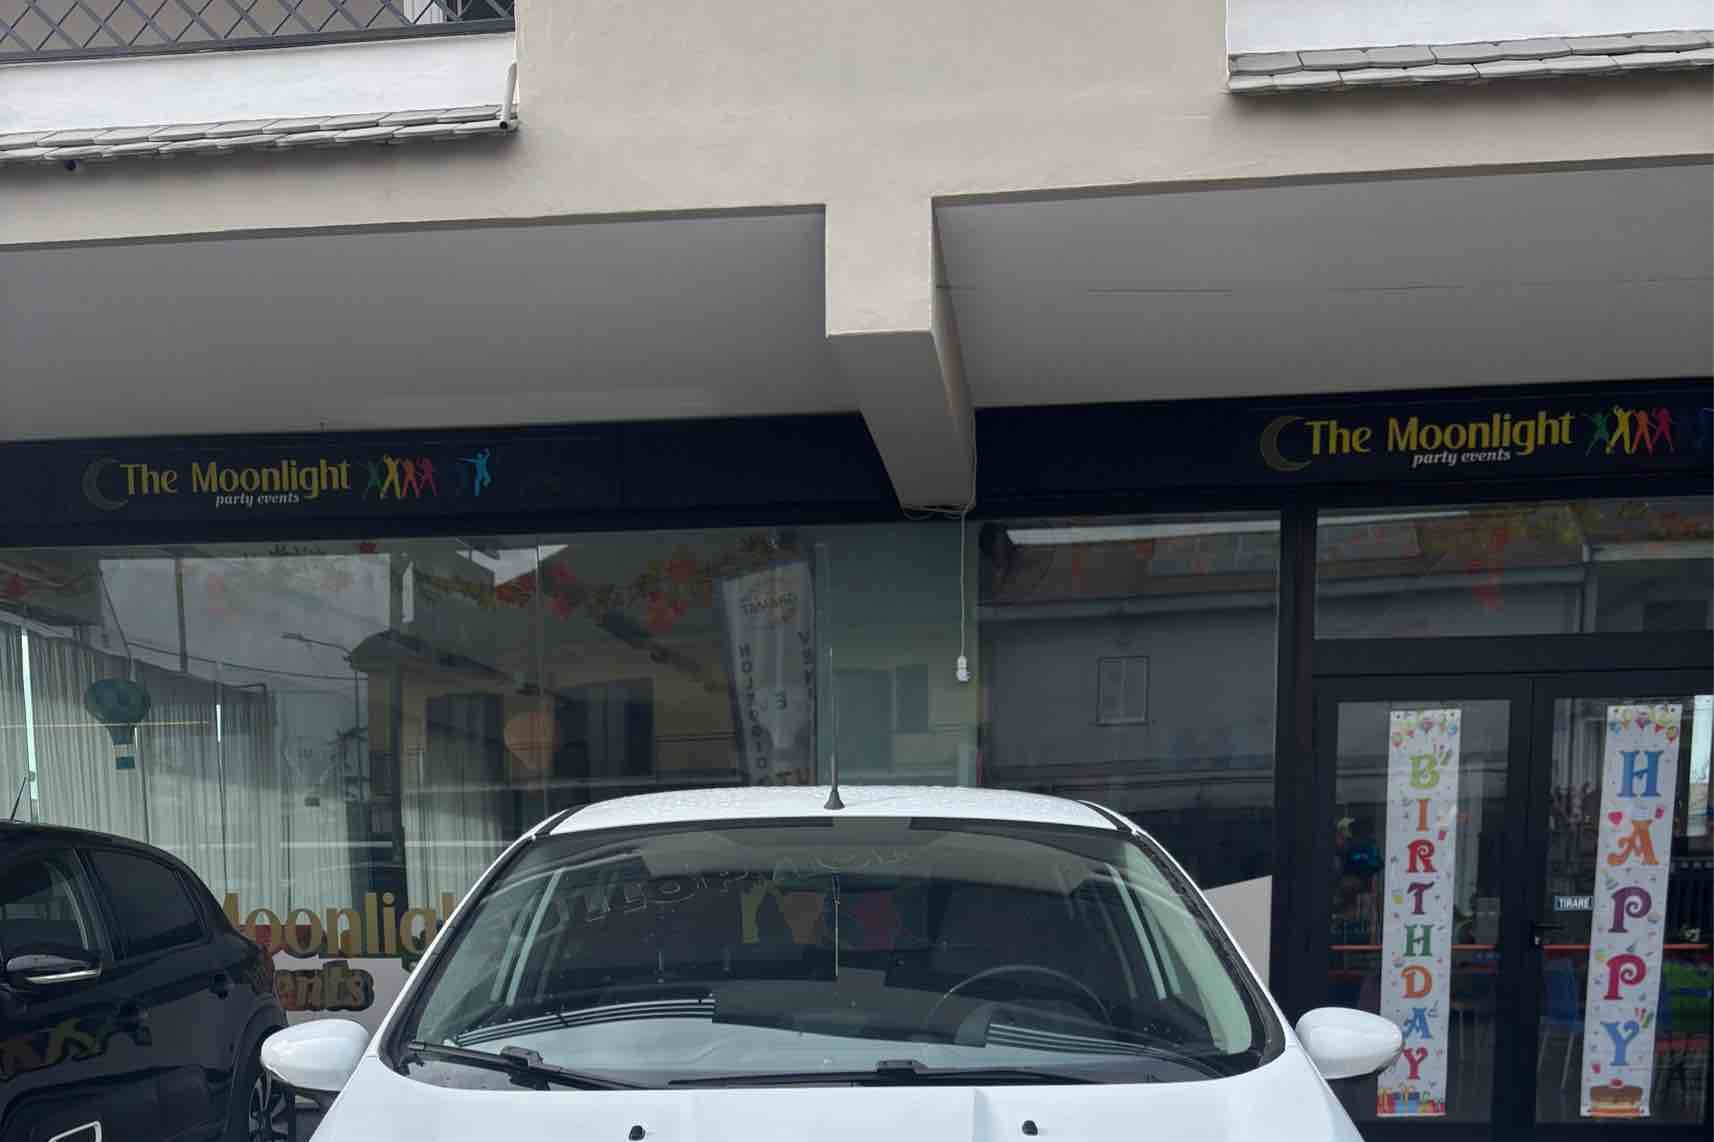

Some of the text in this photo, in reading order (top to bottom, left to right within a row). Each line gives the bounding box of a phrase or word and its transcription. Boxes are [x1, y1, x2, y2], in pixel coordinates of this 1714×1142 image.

[1304, 409, 1576, 457] The Moonlight
[119, 458, 353, 500] The Moonlight
[1410, 446, 1512, 469] party events
[214, 491, 302, 509] party events
[223, 891, 456, 962] oonlig
[1401, 754, 1440, 1080] BIRTHDAY
[1599, 749, 1664, 1067] HAPPY
